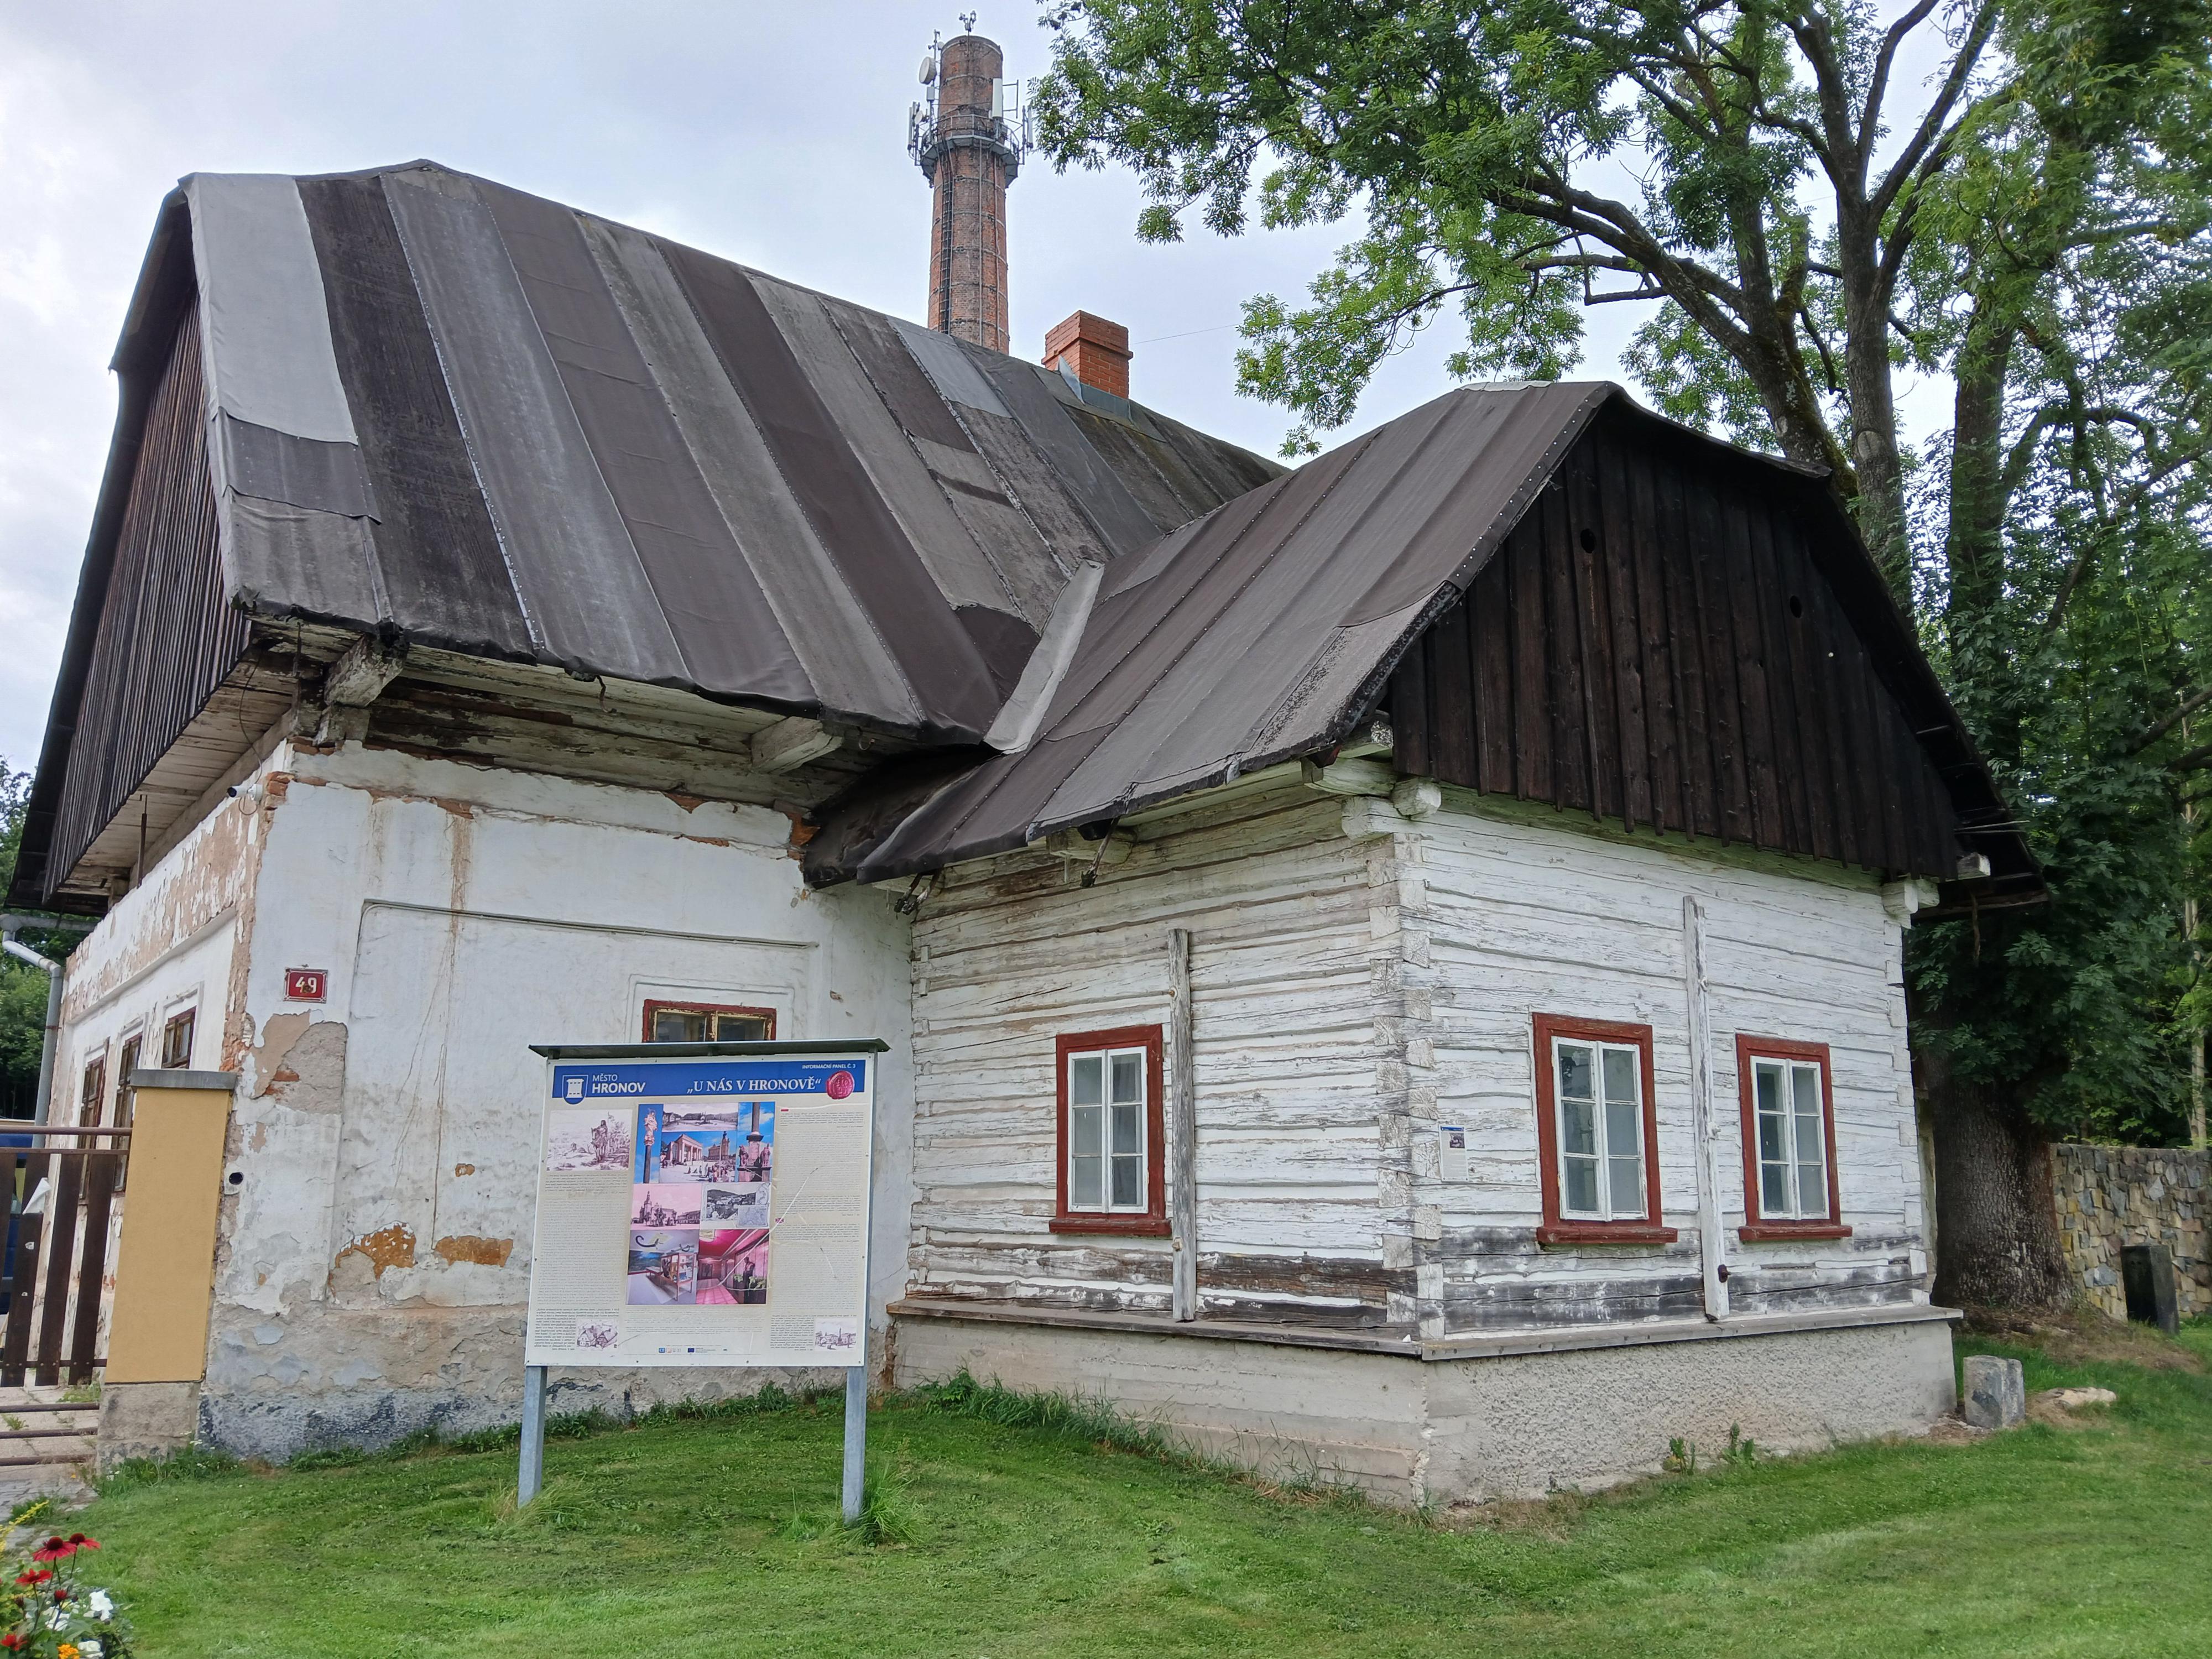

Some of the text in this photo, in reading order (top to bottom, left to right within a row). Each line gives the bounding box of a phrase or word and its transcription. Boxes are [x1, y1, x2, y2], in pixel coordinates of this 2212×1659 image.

[295, 977, 317, 993] 49
[592, 1073, 618, 1082] MĚSTO
[592, 1082, 646, 1093] HRONOV
[707, 1078, 733, 1091] NÁS
[736, 1080, 746, 1091] V
